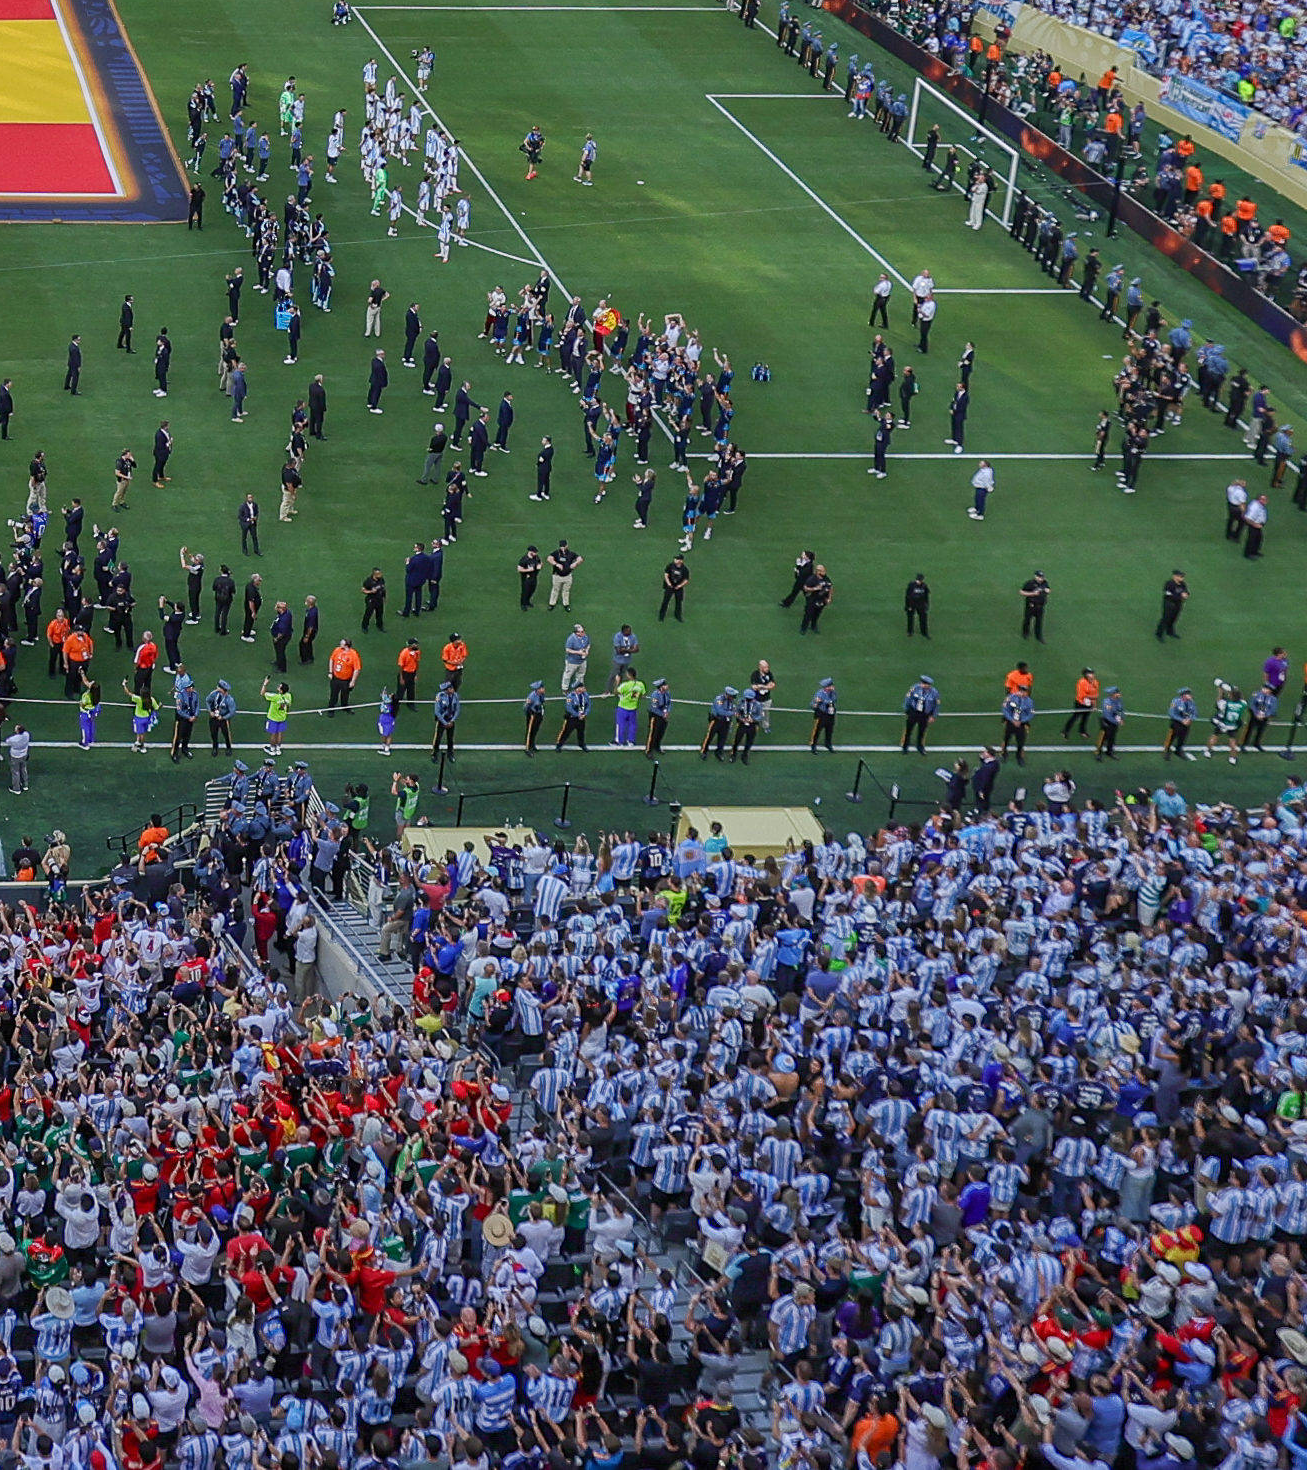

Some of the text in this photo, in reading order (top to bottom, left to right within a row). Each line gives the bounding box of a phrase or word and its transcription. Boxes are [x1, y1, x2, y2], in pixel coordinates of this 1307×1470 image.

[648, 853, 664, 868] 10
[146, 940, 155, 954] 4
[190, 970, 202, 983] 10
